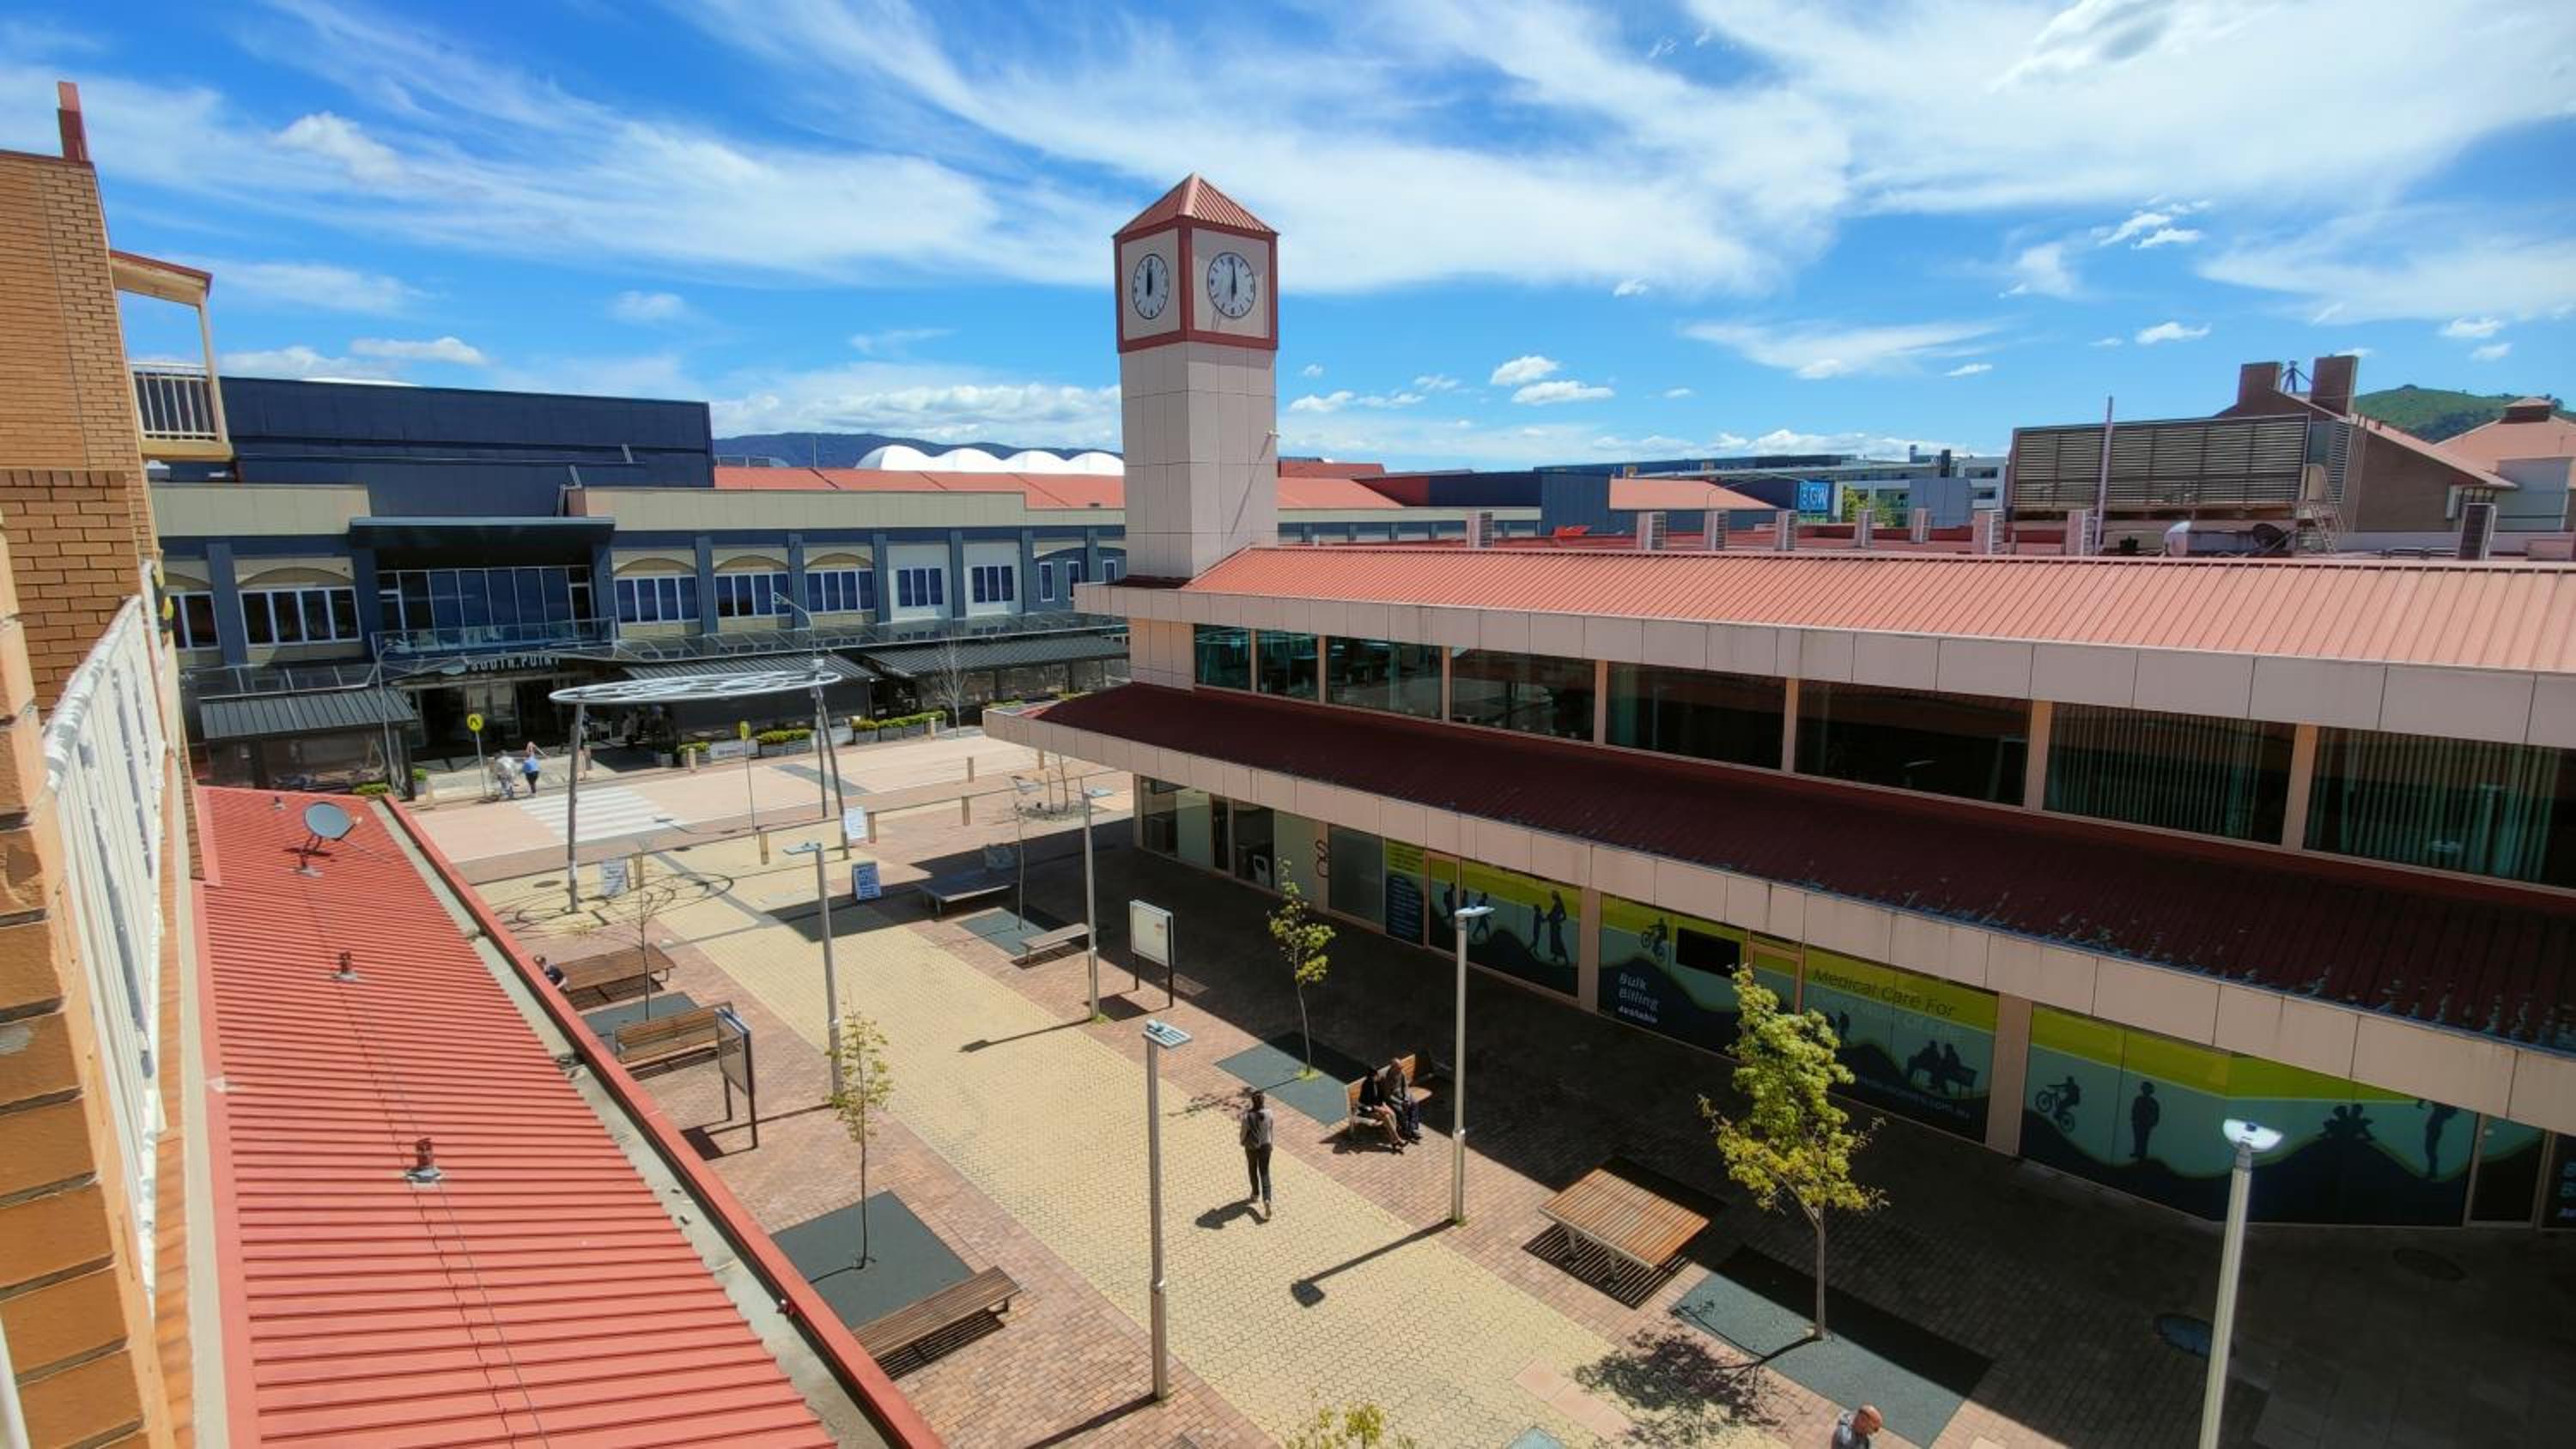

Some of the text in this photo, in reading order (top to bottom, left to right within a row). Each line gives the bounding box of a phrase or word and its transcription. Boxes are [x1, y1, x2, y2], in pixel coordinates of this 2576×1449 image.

[1619, 972, 1648, 991] Bulk
[1812, 967, 1959, 1017] Medical Care For
[1619, 987, 1660, 1011] Billing
